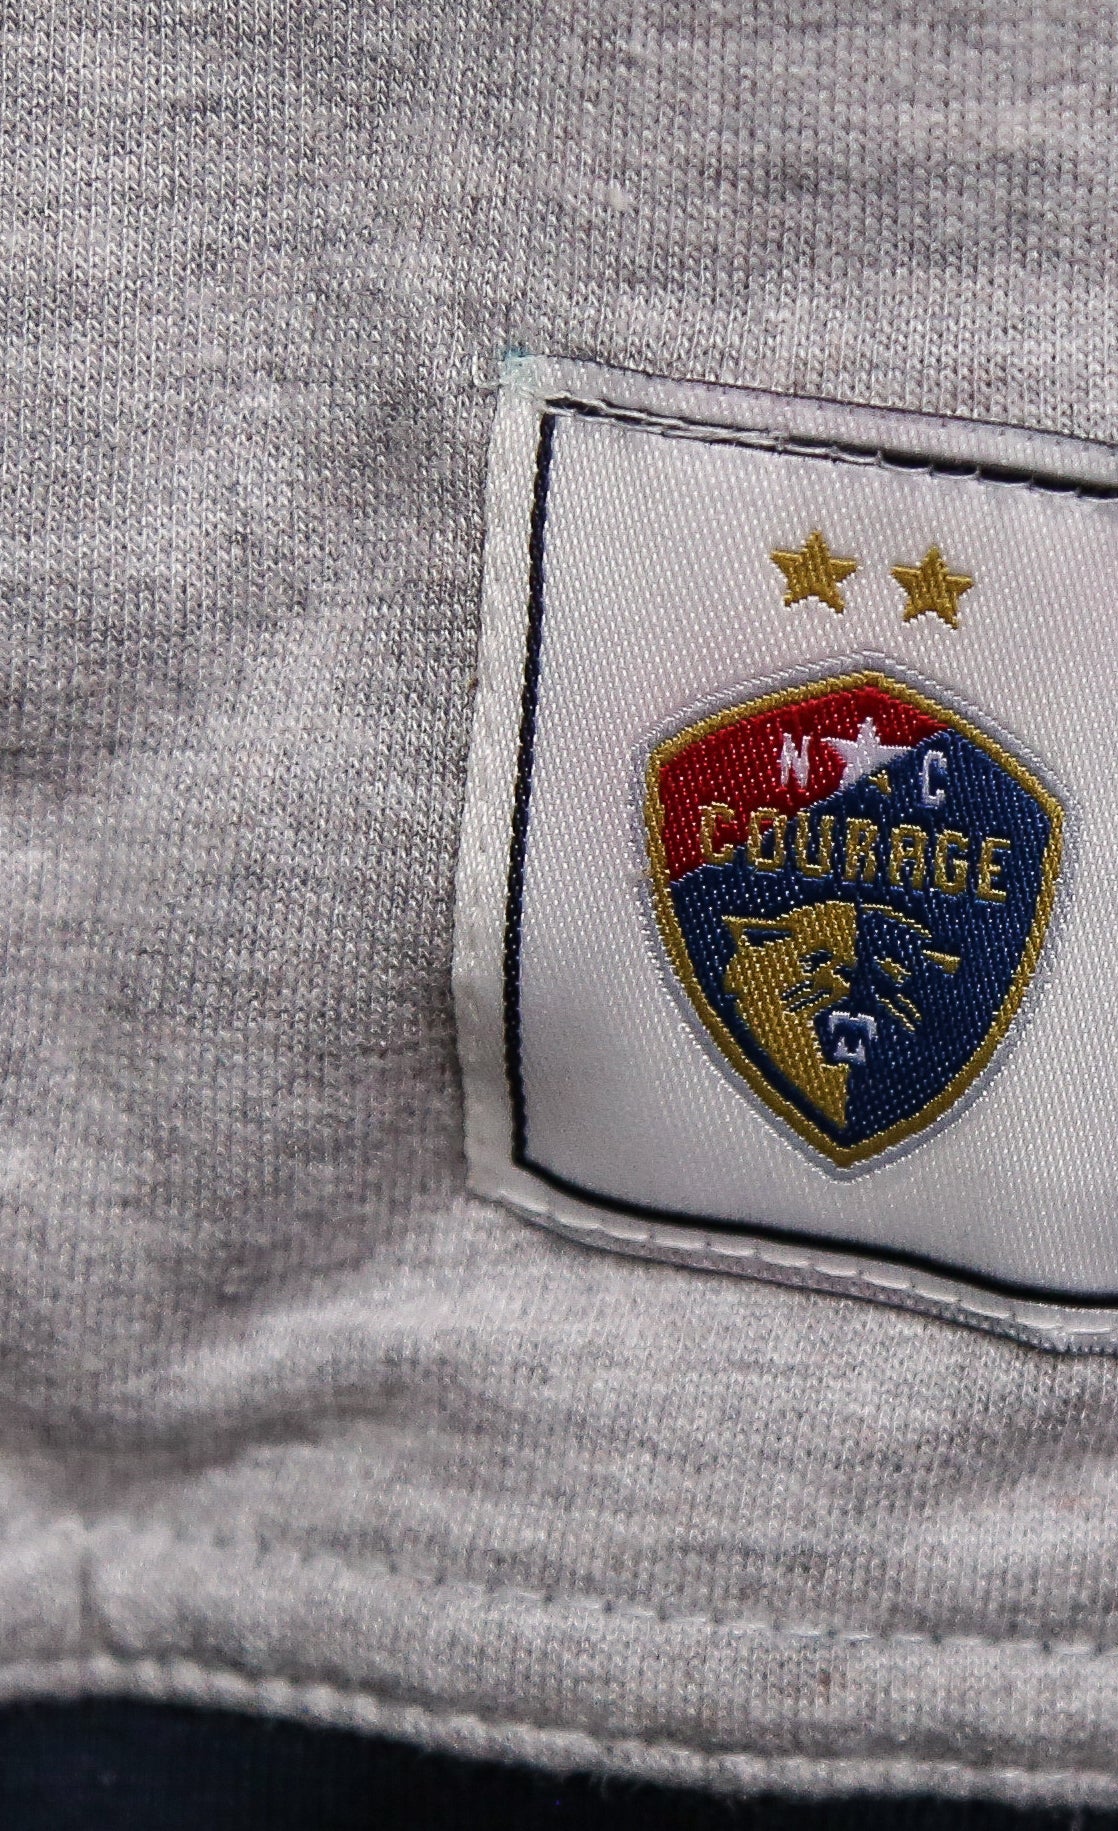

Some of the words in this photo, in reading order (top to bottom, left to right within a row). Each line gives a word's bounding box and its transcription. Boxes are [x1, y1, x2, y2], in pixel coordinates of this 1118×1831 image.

[779, 732, 812, 789] N
[922, 749, 948, 808] C
[699, 801, 1013, 902] COURAGE
